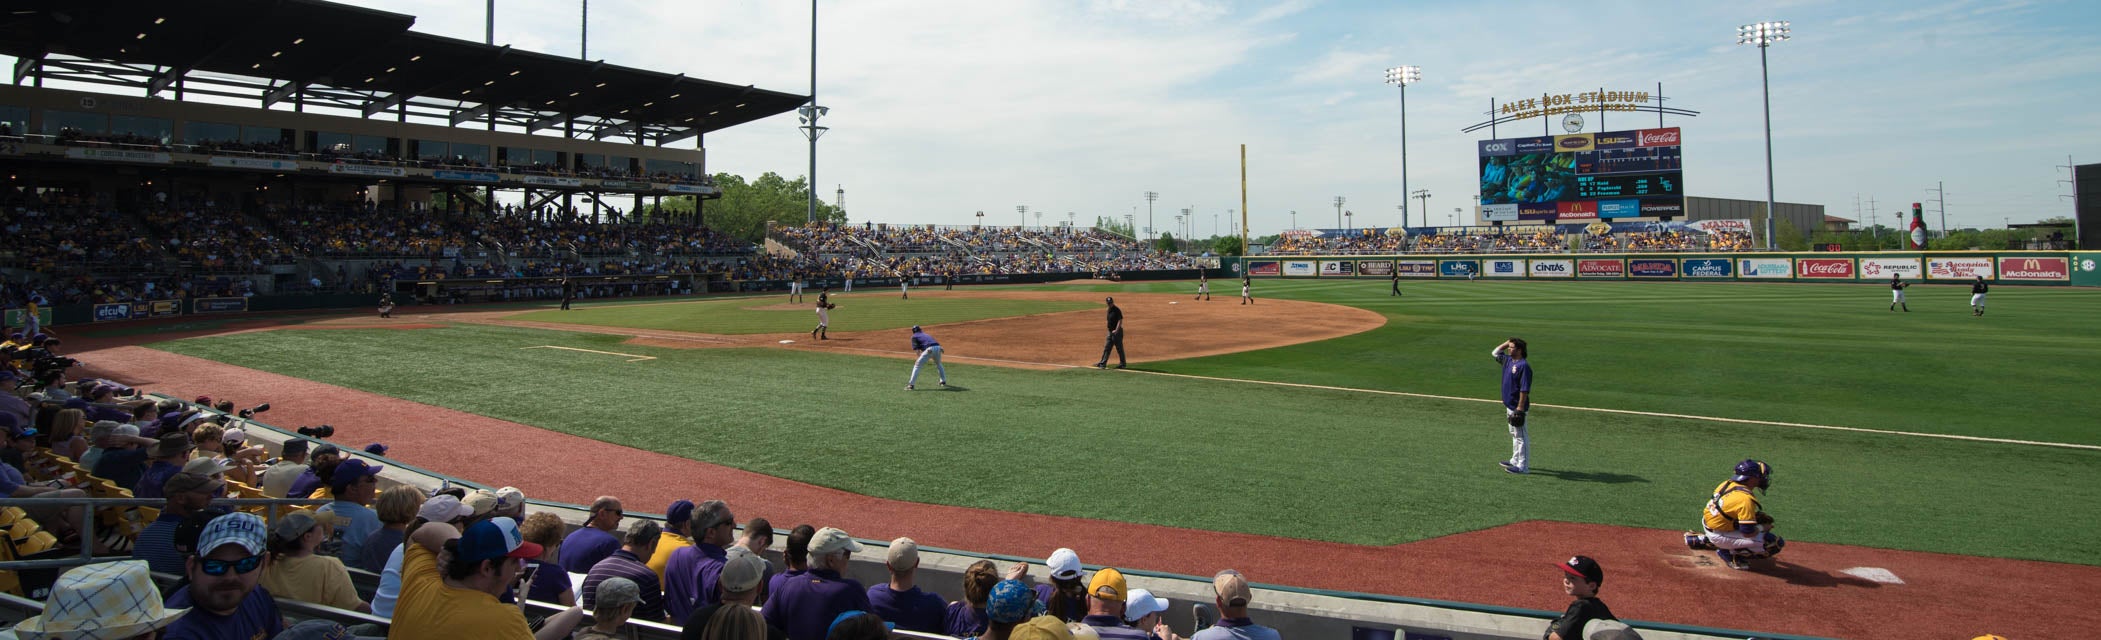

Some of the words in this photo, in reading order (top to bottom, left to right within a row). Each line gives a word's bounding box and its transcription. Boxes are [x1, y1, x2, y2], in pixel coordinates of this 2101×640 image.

[1502, 98, 1536, 114] ALEX
[1542, 94, 1572, 107] BOX
[1579, 91, 1649, 103] STADIUM
[1515, 109, 1539, 120] SKIP
[1543, 104, 1600, 116] BERTMAN
[1603, 104, 1637, 112] FIELD
[1597, 137, 1617, 145] LSU
[1644, 132, 1678, 144] Coca-Cola
[1485, 143, 1508, 152] COX
[1701, 220, 1744, 230] MANDA
[1450, 262, 1467, 270] LHC
[1581, 264, 1621, 272] ADVOCATE
[1632, 262, 1672, 272] MANDA
[1810, 262, 1849, 274] Coca-Cola
[99, 306, 118, 317] efcu
[214, 520, 255, 533] LSU
